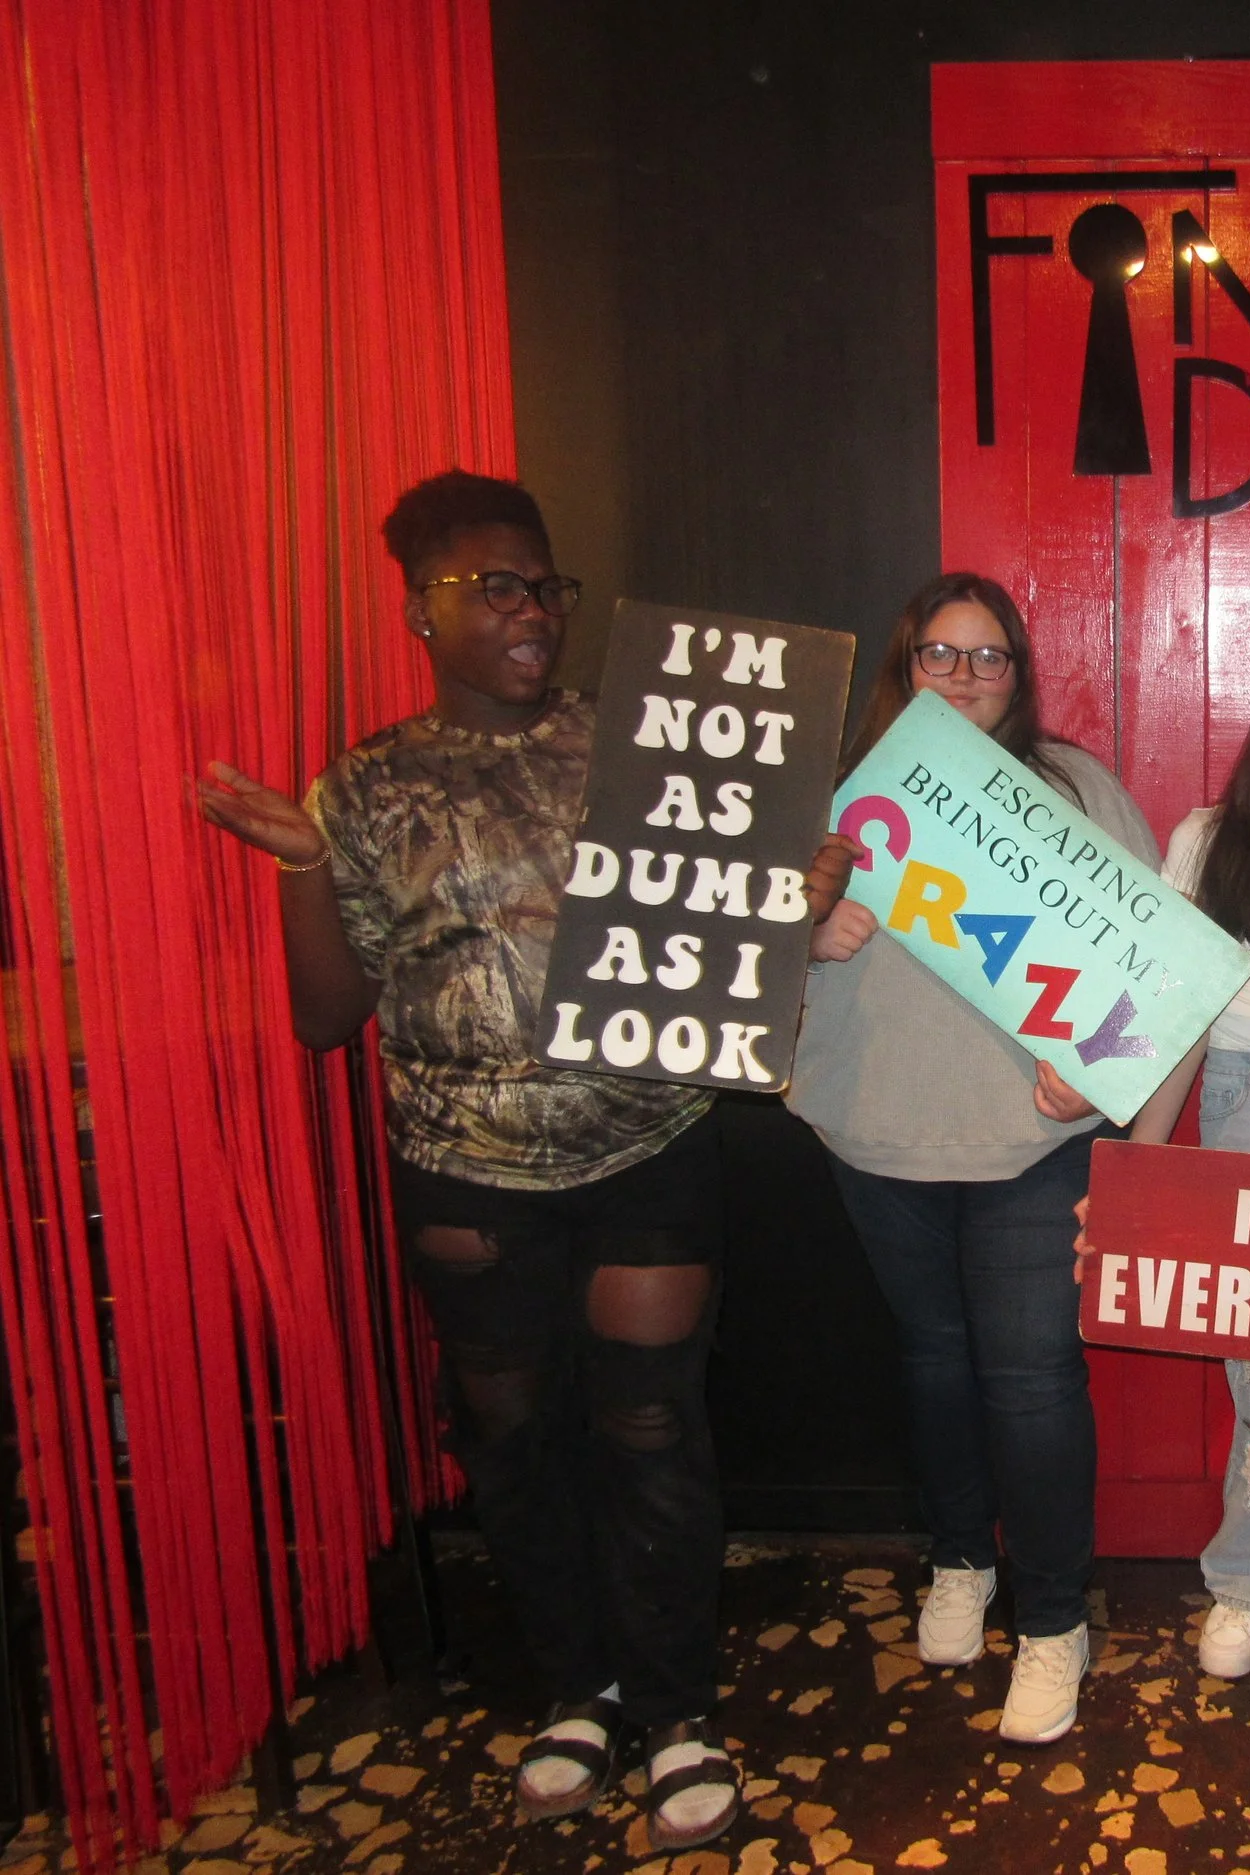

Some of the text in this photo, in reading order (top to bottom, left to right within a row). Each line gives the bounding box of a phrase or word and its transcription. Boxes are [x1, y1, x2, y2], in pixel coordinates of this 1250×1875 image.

[661, 623, 788, 690] I'M
[633, 694, 795, 765] NOT
[645, 775, 753, 837] AS
[980, 767, 1161, 925] ESCAPING
[564, 841, 809, 923] DUMB
[899, 762, 1185, 998] BRINGS OUT MY
[586, 926, 763, 999] AS I
[837, 795, 1160, 1067] CRAZY
[546, 1002, 773, 1083] LOOK
